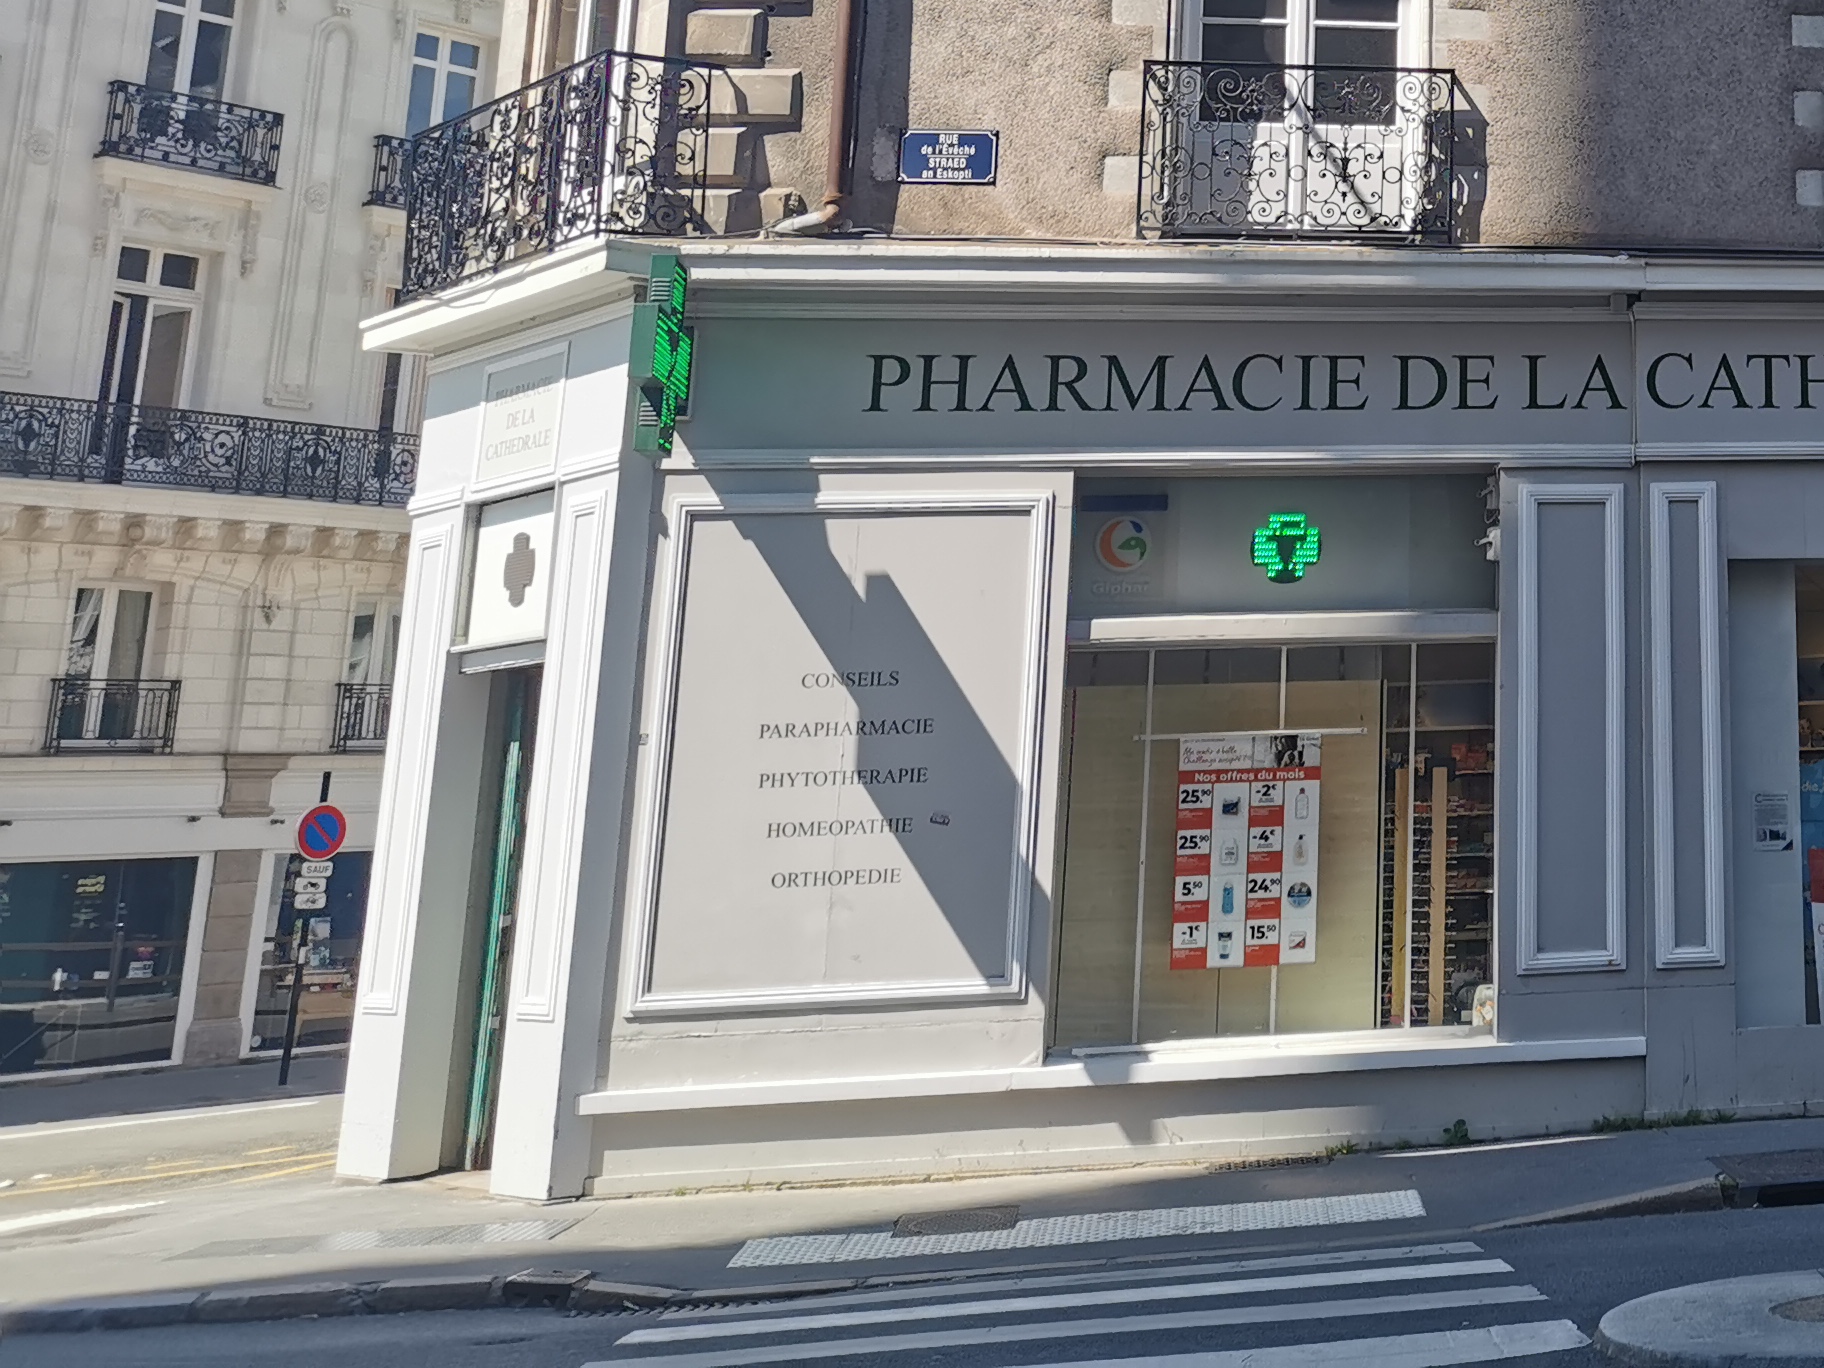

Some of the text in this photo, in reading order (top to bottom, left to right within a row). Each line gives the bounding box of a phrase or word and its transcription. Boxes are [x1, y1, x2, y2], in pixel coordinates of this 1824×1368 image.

[939, 134, 959, 144] RUE
[921, 143, 976, 155] de l'Évêché
[928, 157, 966, 168] STRAED
[922, 168, 972, 180] an Eskopti
[861, 352, 1370, 413] PHARMACIE
[1391, 353, 1499, 411] DE
[1521, 353, 1629, 410] LA
[506, 407, 535, 430] DE LA
[485, 428, 552, 461] CATHEDRALE
[1092, 580, 1149, 595] Giphar
[801, 670, 900, 689] CONSEILS
[758, 718, 935, 740] PARAPHARMACIE
[758, 767, 929, 789] PHYTOTHERAPIE
[1194, 768, 1305, 782] Nos offres du mois
[1256, 784, 1277, 797] -2€
[766, 817, 913, 839] HOMEOPATHIE
[1252, 829, 1275, 842] -4€
[307, 865, 330, 874] SAUF
[771, 868, 902, 889] ORTHOPEDIE
[1181, 925, 1200, 938] -1€
